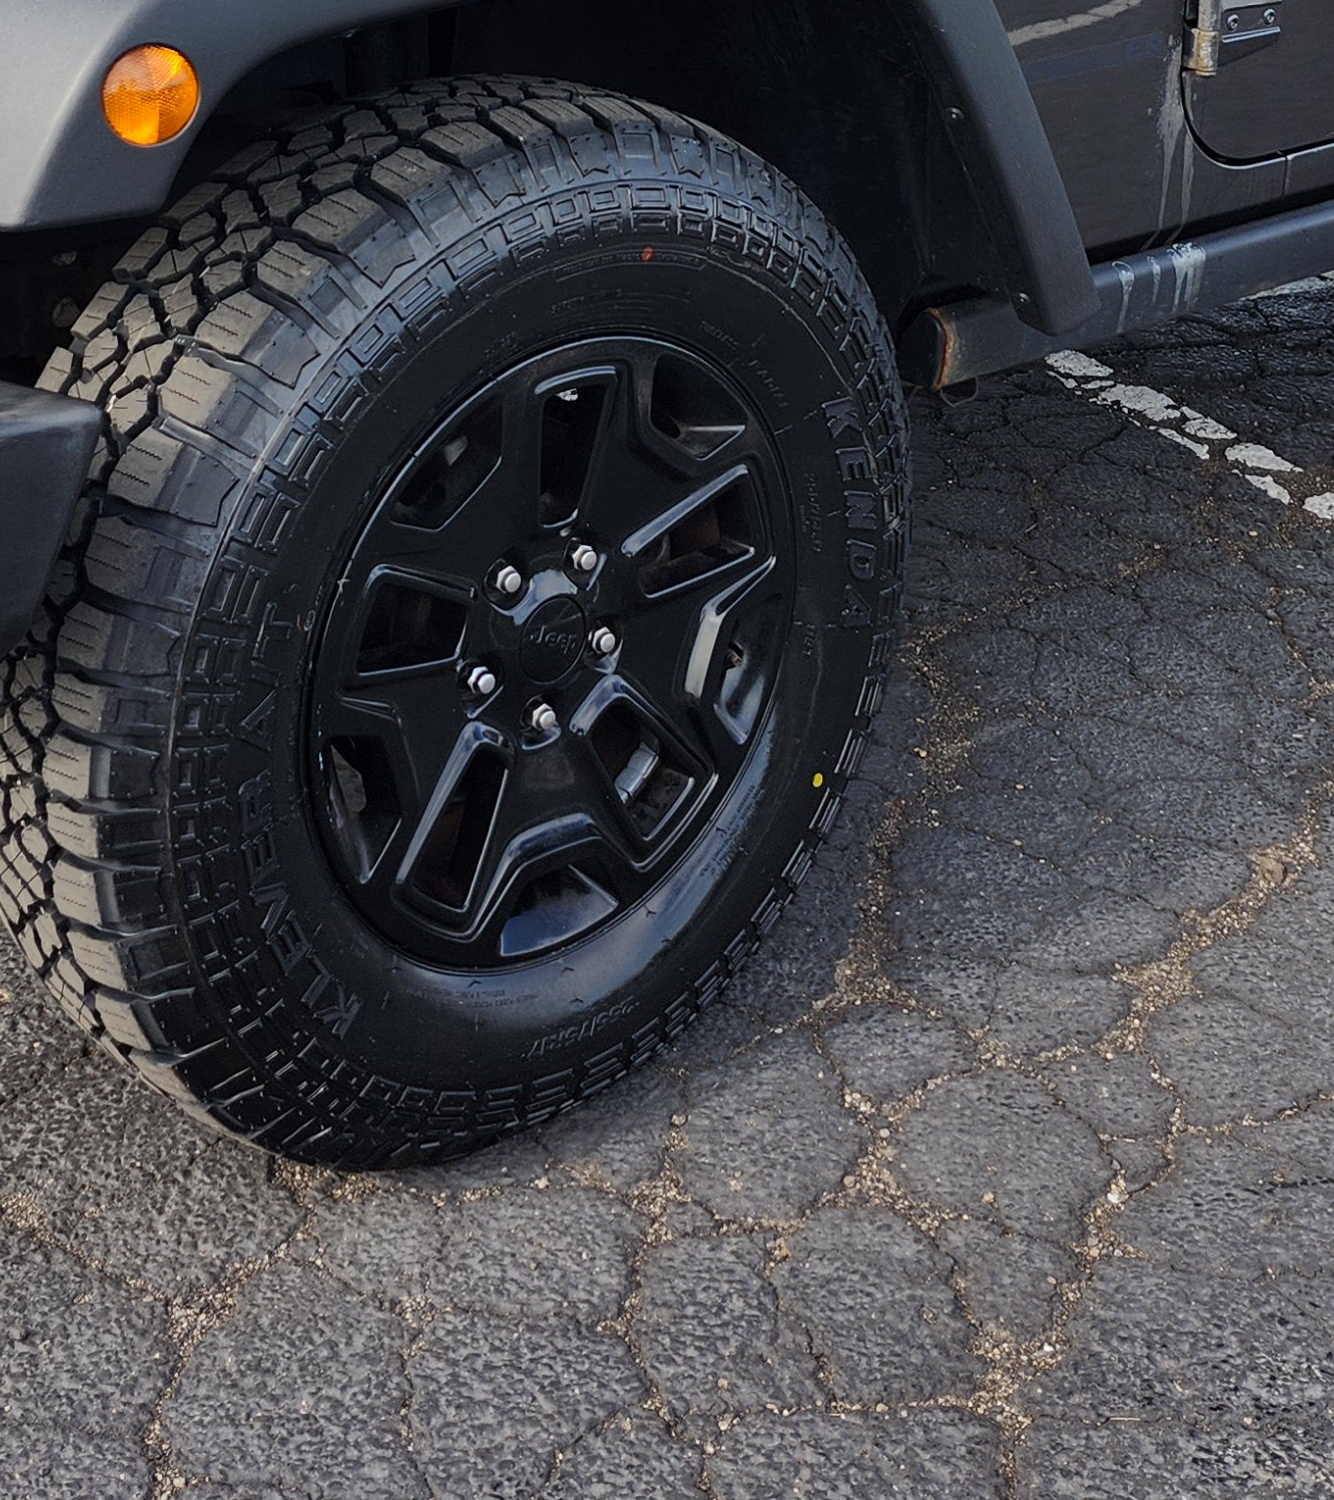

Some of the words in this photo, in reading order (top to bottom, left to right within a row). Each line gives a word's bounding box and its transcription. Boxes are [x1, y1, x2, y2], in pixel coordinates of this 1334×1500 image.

[820, 396, 875, 627] KENDA
[531, 625, 576, 655] Jeep
[237, 769, 364, 1041] KLEVER
